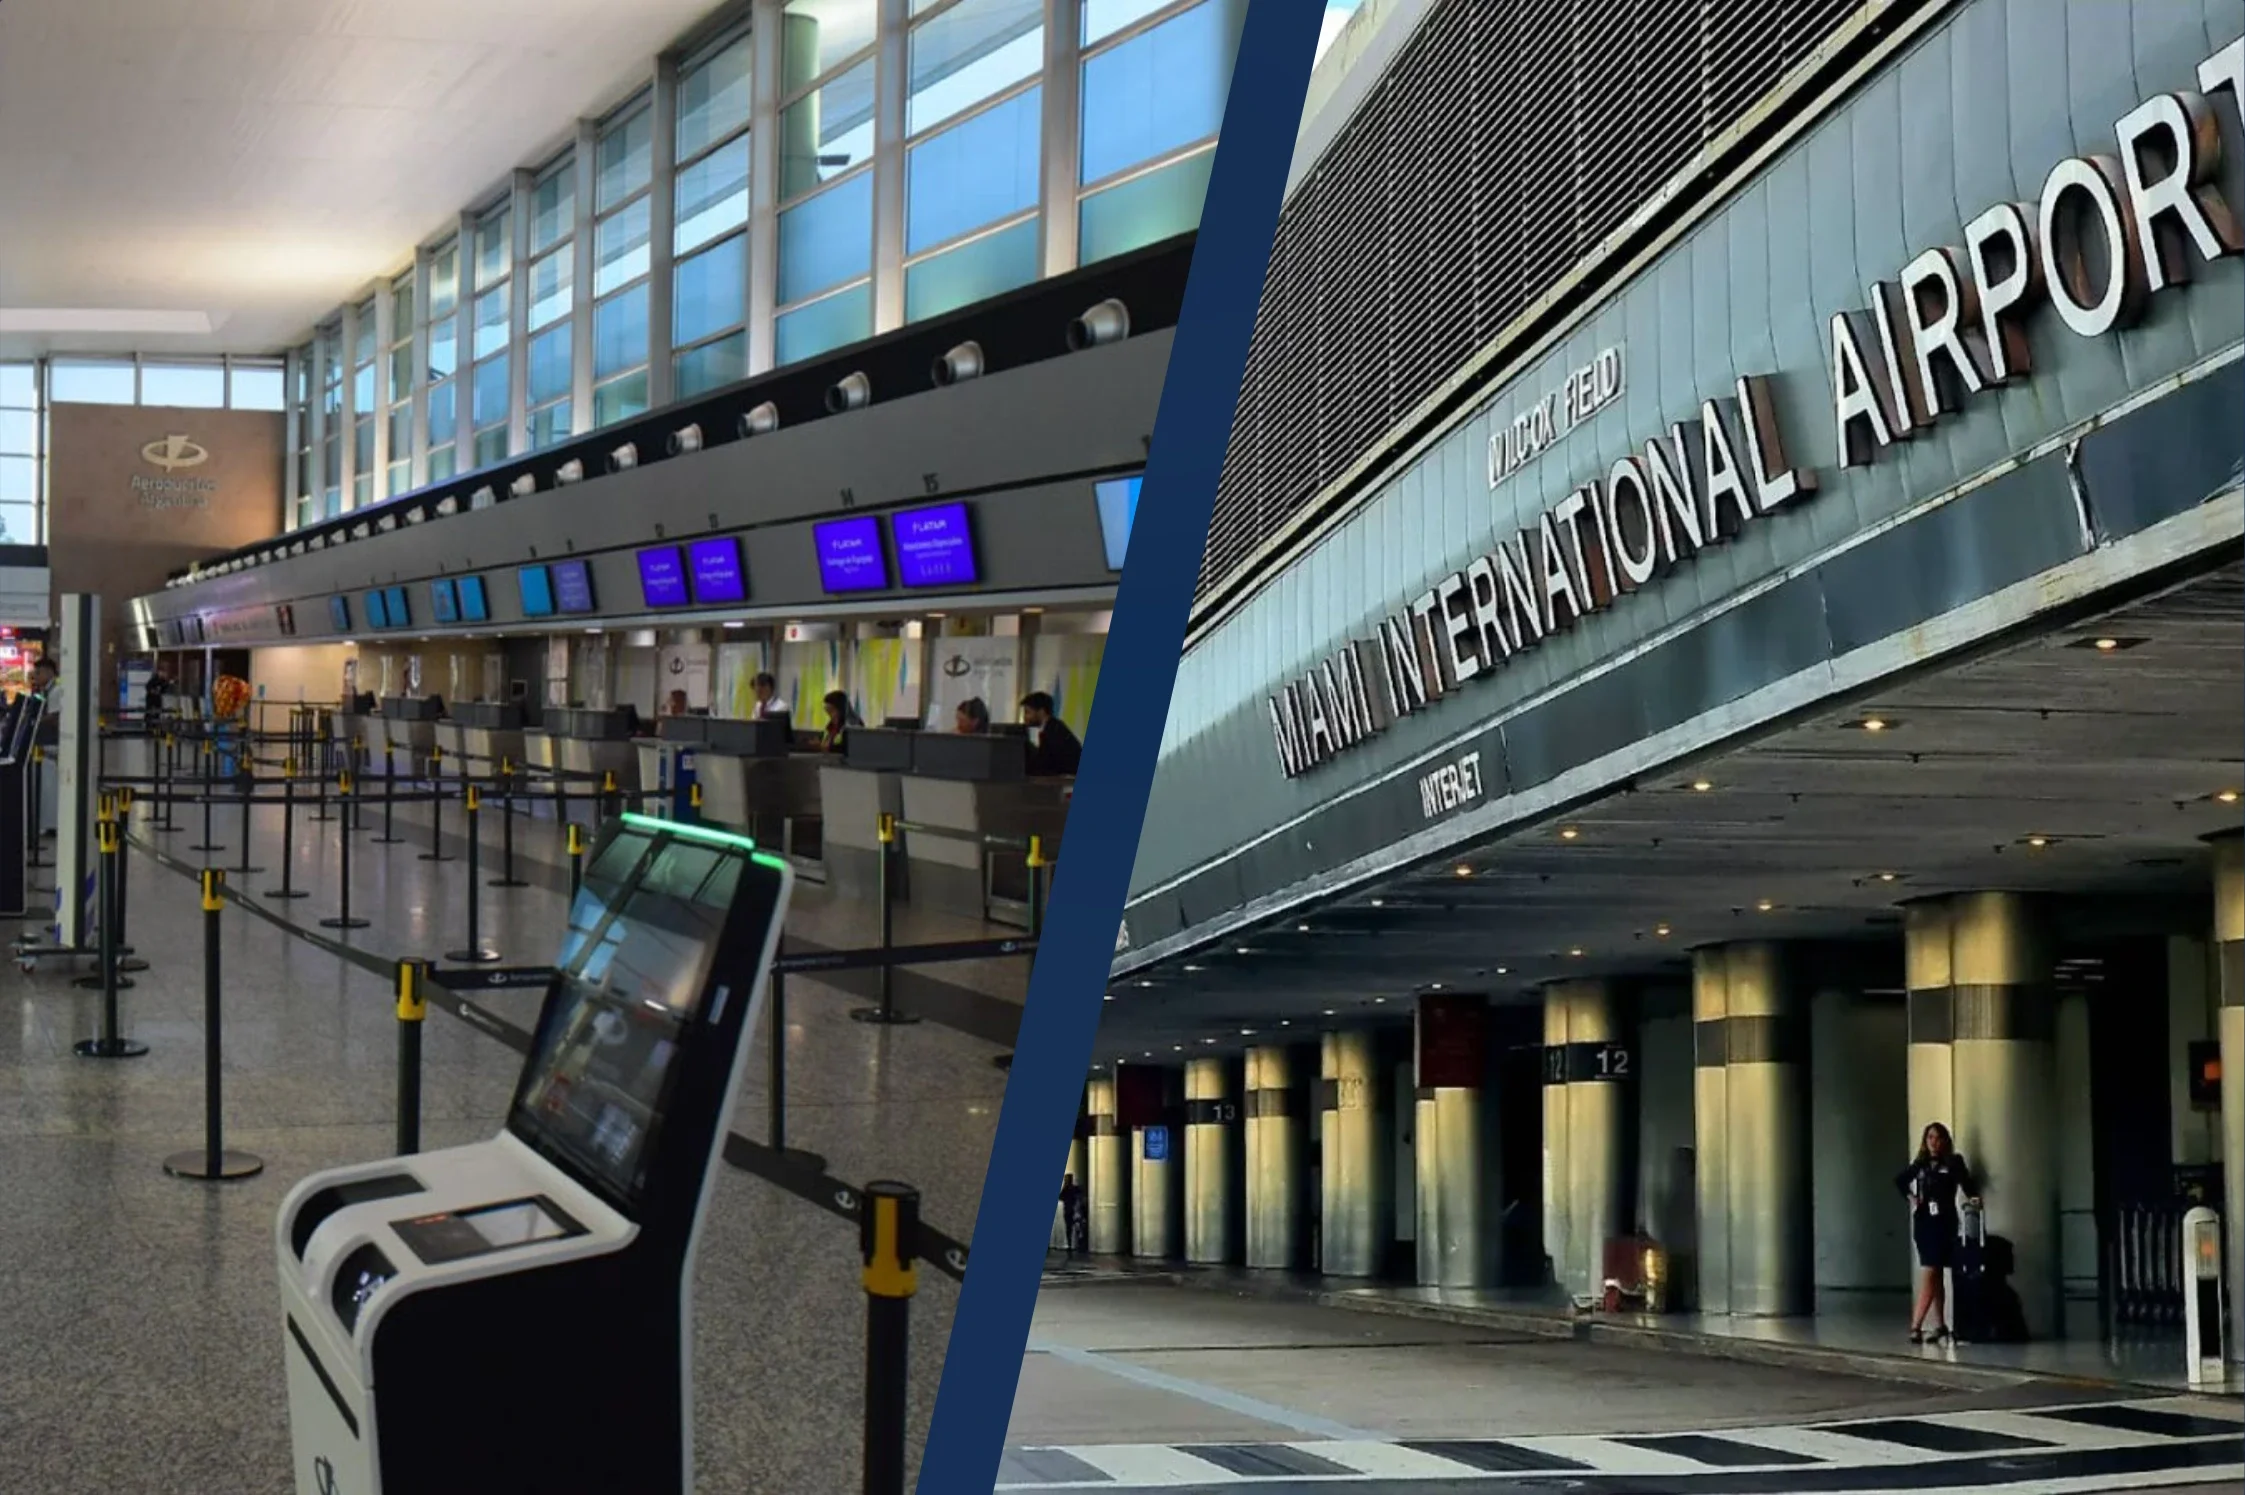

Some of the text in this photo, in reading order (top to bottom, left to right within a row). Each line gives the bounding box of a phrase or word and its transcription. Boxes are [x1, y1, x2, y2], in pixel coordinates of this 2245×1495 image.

[1489, 348, 1621, 485] WILCOX FIELD
[1268, 639, 1373, 780] MIAMI
[1376, 375, 1797, 718] INTERNATIONAL
[1418, 750, 1483, 818] INTERJET
[1596, 1048, 1629, 1074] 12
[1212, 1103, 1236, 1121] 13
